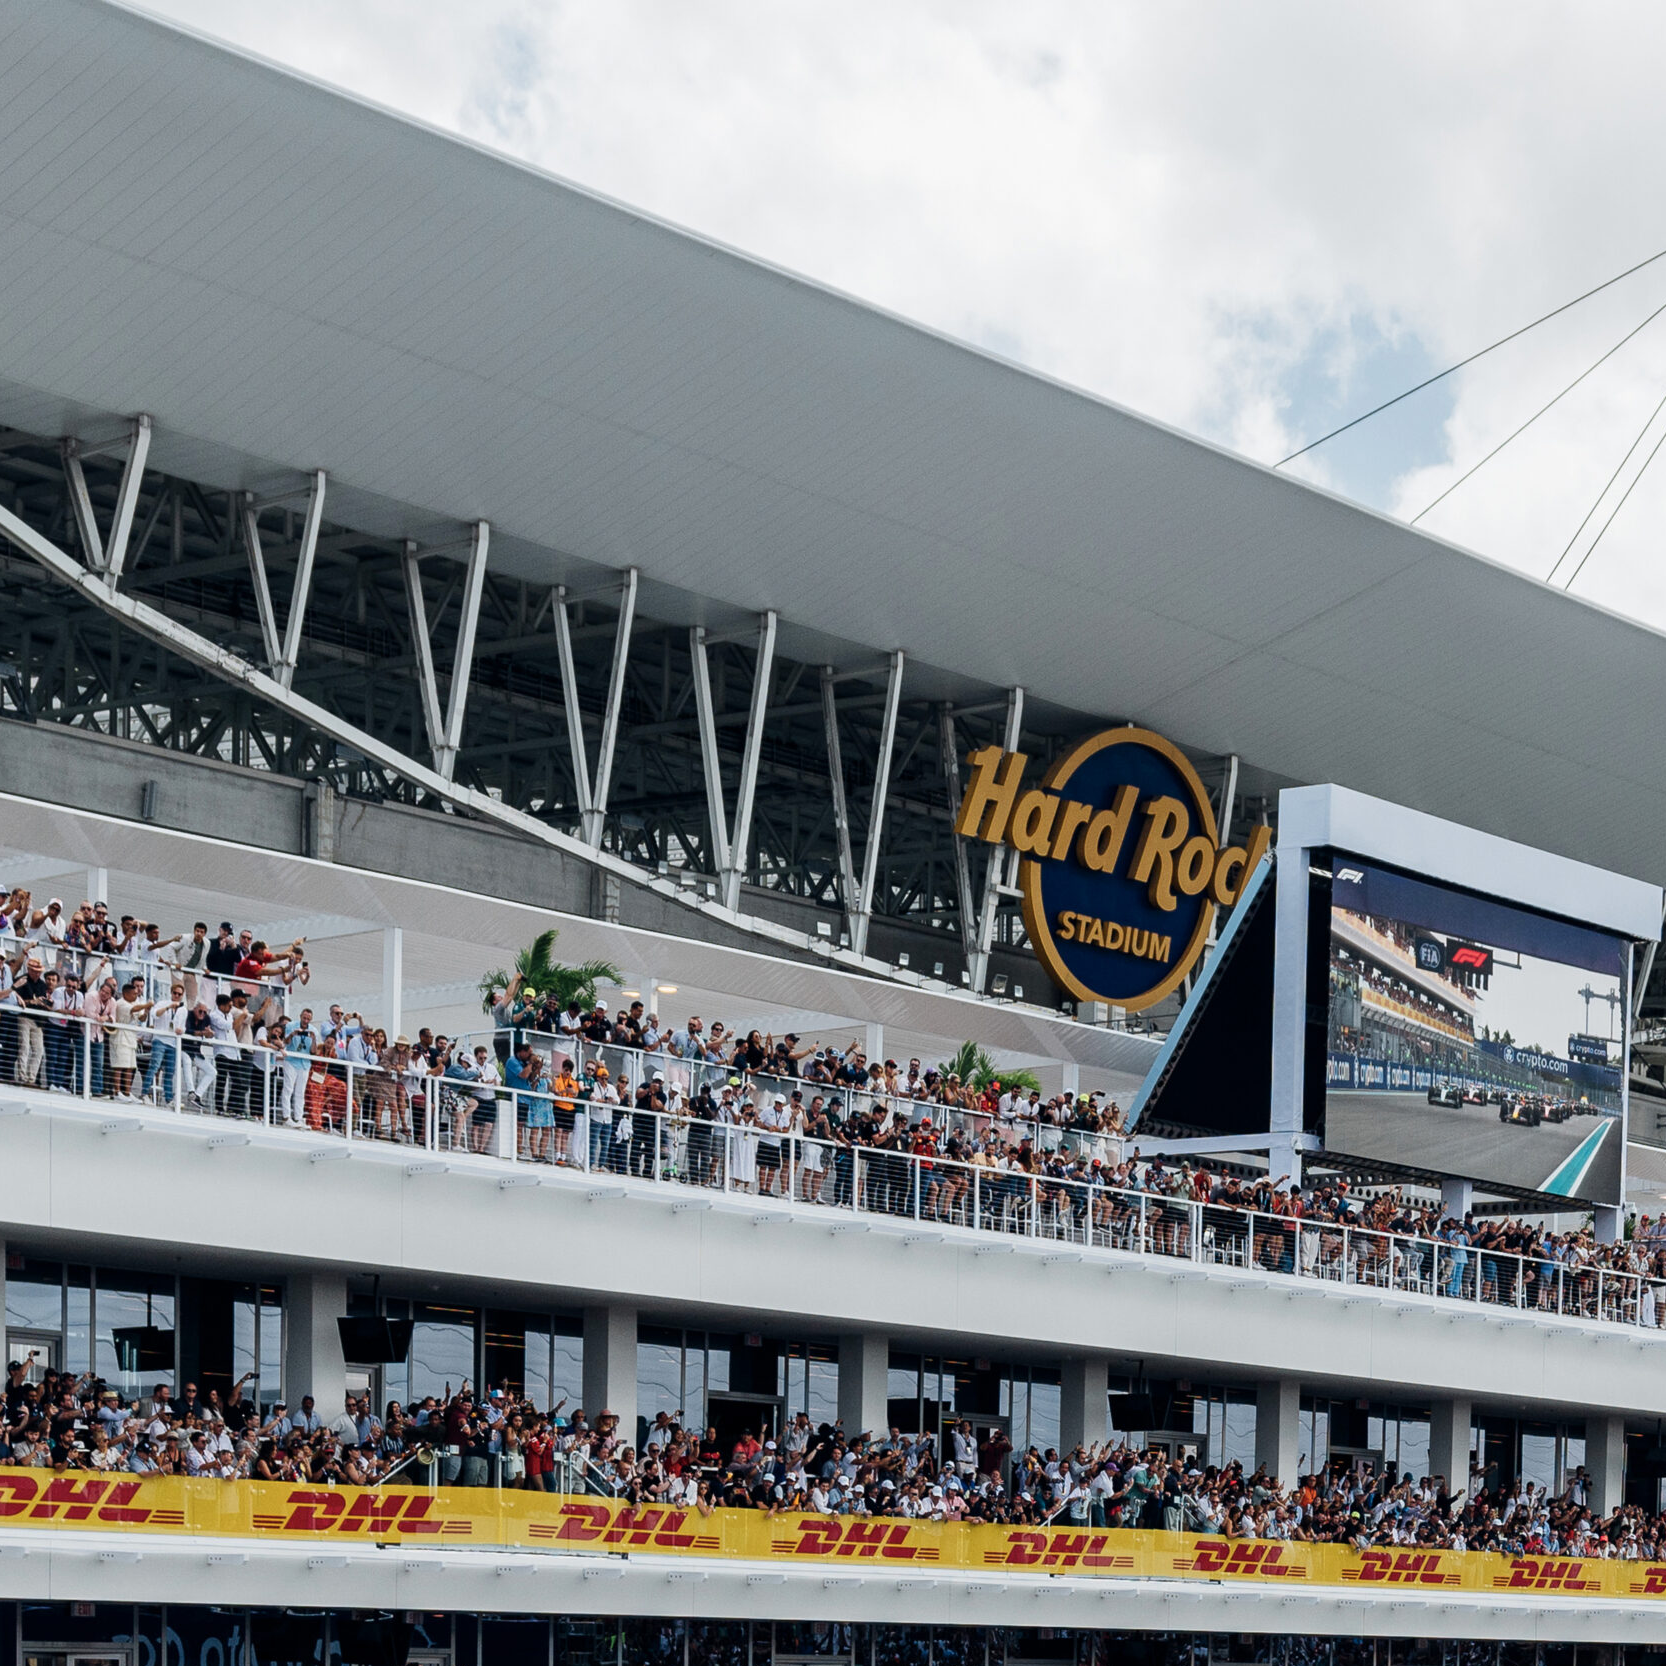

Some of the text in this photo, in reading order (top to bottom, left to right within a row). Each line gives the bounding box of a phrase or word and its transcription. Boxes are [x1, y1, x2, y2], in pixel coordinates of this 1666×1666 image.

[953, 745, 1140, 874] Hard
[1057, 911, 1172, 963] STADIUM
[1420, 948, 1440, 964] FIA
[1516, 1051, 1569, 1075] crypto.com
[1576, 1043, 1607, 1057] crypto.com
[284, 1491, 442, 1534] DHL
[557, 1503, 695, 1547] DHL
[795, 1520, 917, 1559] DHL
[1006, 1532, 1113, 1567] DHL
[1193, 1541, 1288, 1577] DHL
[1358, 1552, 1443, 1584] DHL
[1508, 1560, 1586, 1590] DHL
